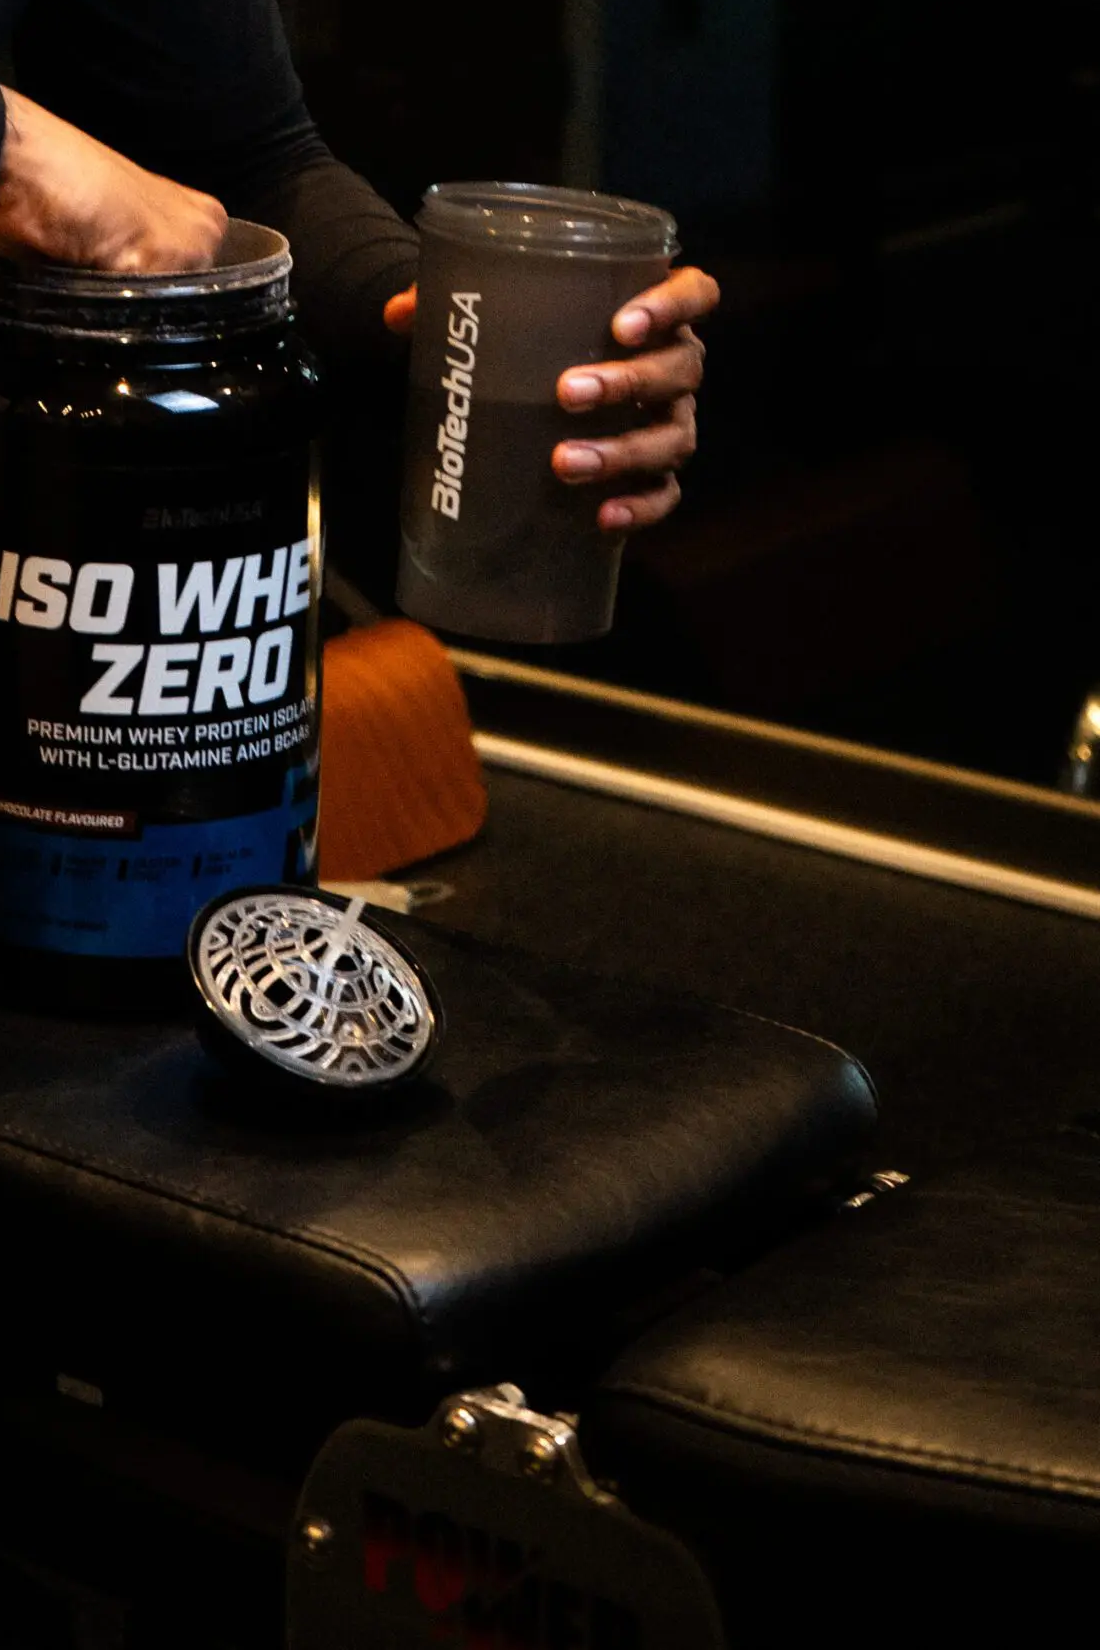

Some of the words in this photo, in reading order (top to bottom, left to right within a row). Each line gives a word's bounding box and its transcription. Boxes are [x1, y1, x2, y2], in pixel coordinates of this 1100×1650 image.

[429, 290, 482, 522] BioTechUSA
[156, 535, 324, 637] WHE
[78, 623, 295, 717] ZERO
[26, 717, 123, 747] PREMIUM
[127, 724, 190, 747] WHEY
[194, 712, 270, 744] PROTEIN
[38, 745, 92, 769] WITH
[97, 745, 233, 772] L-GLUTAMINE
[235, 737, 271, 763] AND
[54, 810, 126, 829] FLAVOURED
